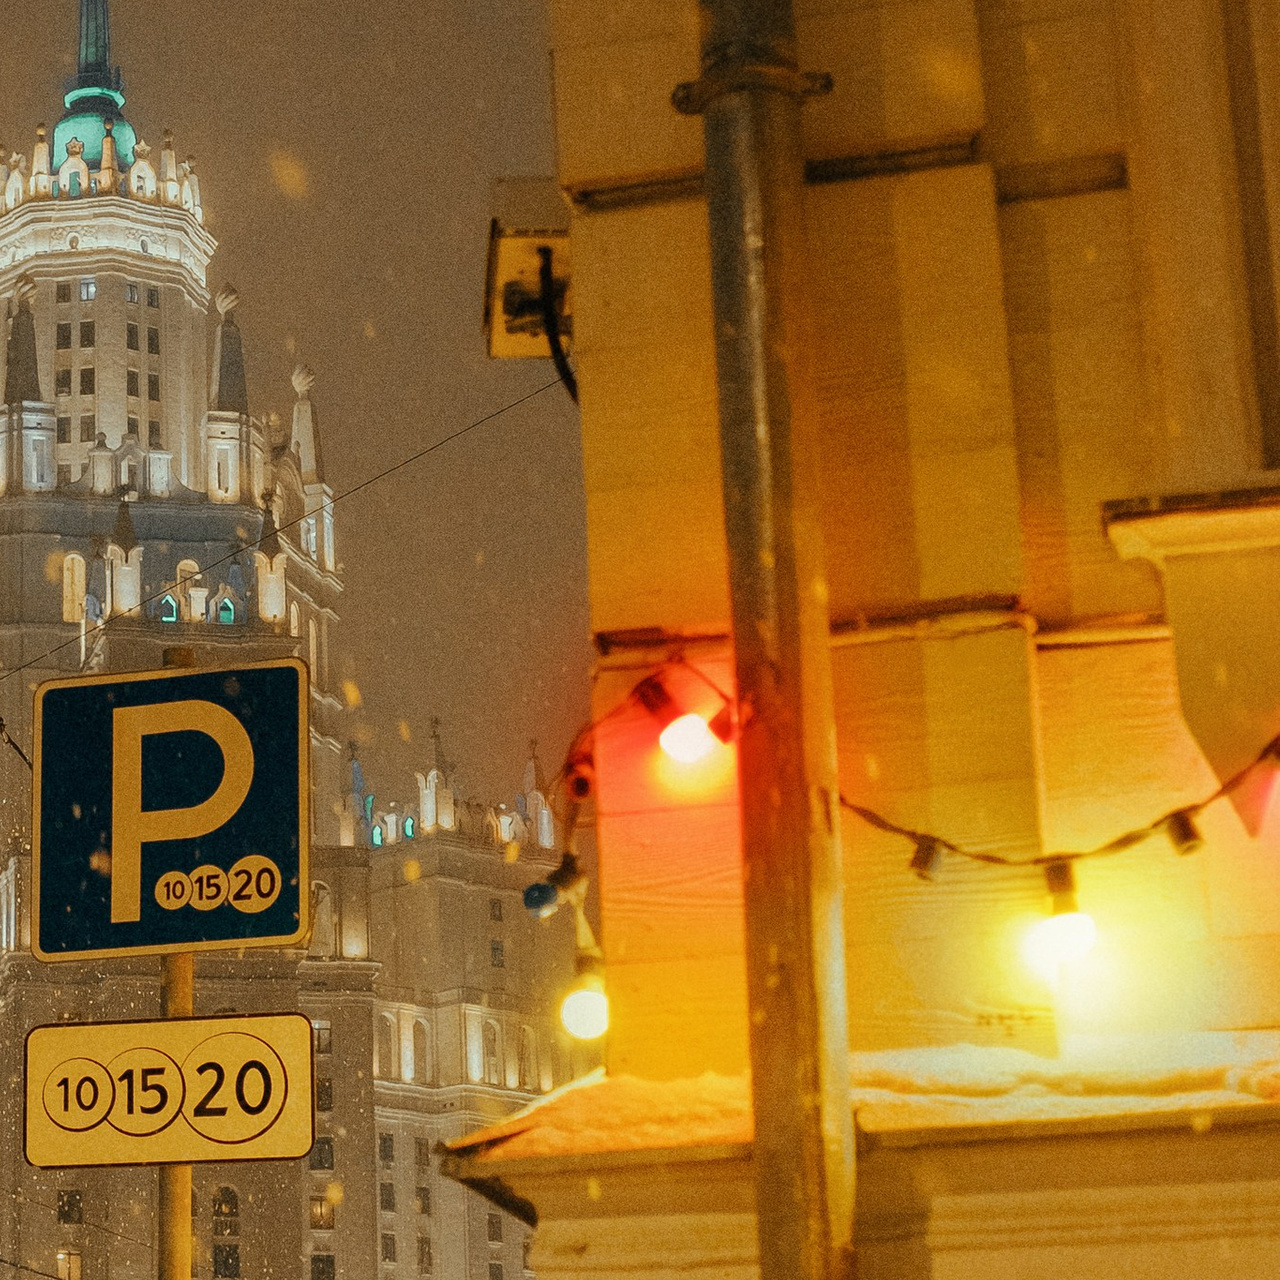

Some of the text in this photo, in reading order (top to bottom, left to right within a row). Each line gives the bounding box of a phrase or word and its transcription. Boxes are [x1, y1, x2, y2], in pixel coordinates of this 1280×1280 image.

[110, 699, 255, 924] P
[163, 866, 277, 902] 10 15 20
[56, 1059, 273, 1119] 10 15 20
